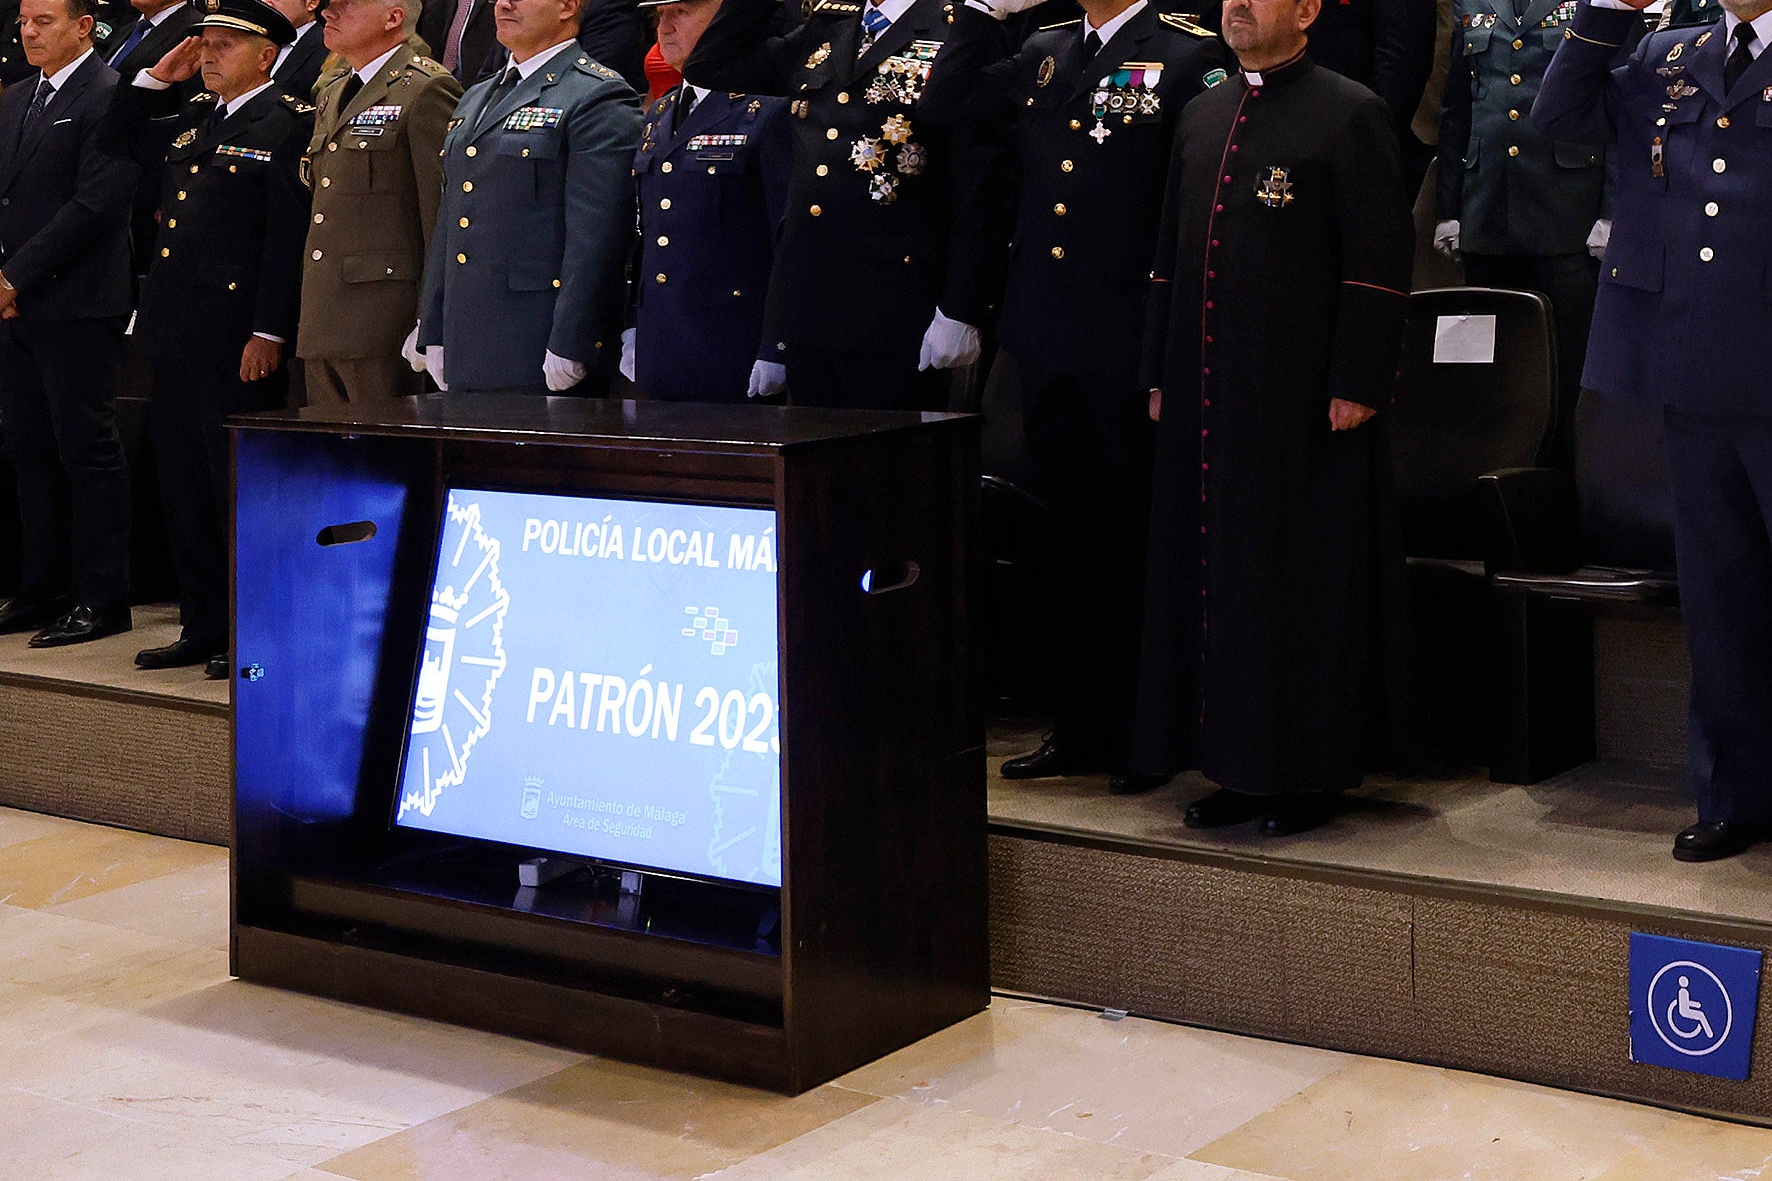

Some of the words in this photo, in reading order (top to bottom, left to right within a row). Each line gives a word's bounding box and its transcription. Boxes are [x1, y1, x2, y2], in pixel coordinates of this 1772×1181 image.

[522, 515, 624, 559] POLICÍA
[631, 523, 720, 568] LOCAL
[727, 526, 777, 573] MÁ
[526, 664, 684, 742] PATRÓN
[546, 791, 624, 815] Ayuntamiento
[626, 803, 641, 817] de
[643, 805, 686, 826] Málaga
[562, 810, 586, 829] Área
[587, 817, 601, 831] de
[602, 818, 653, 839] Seguridad
